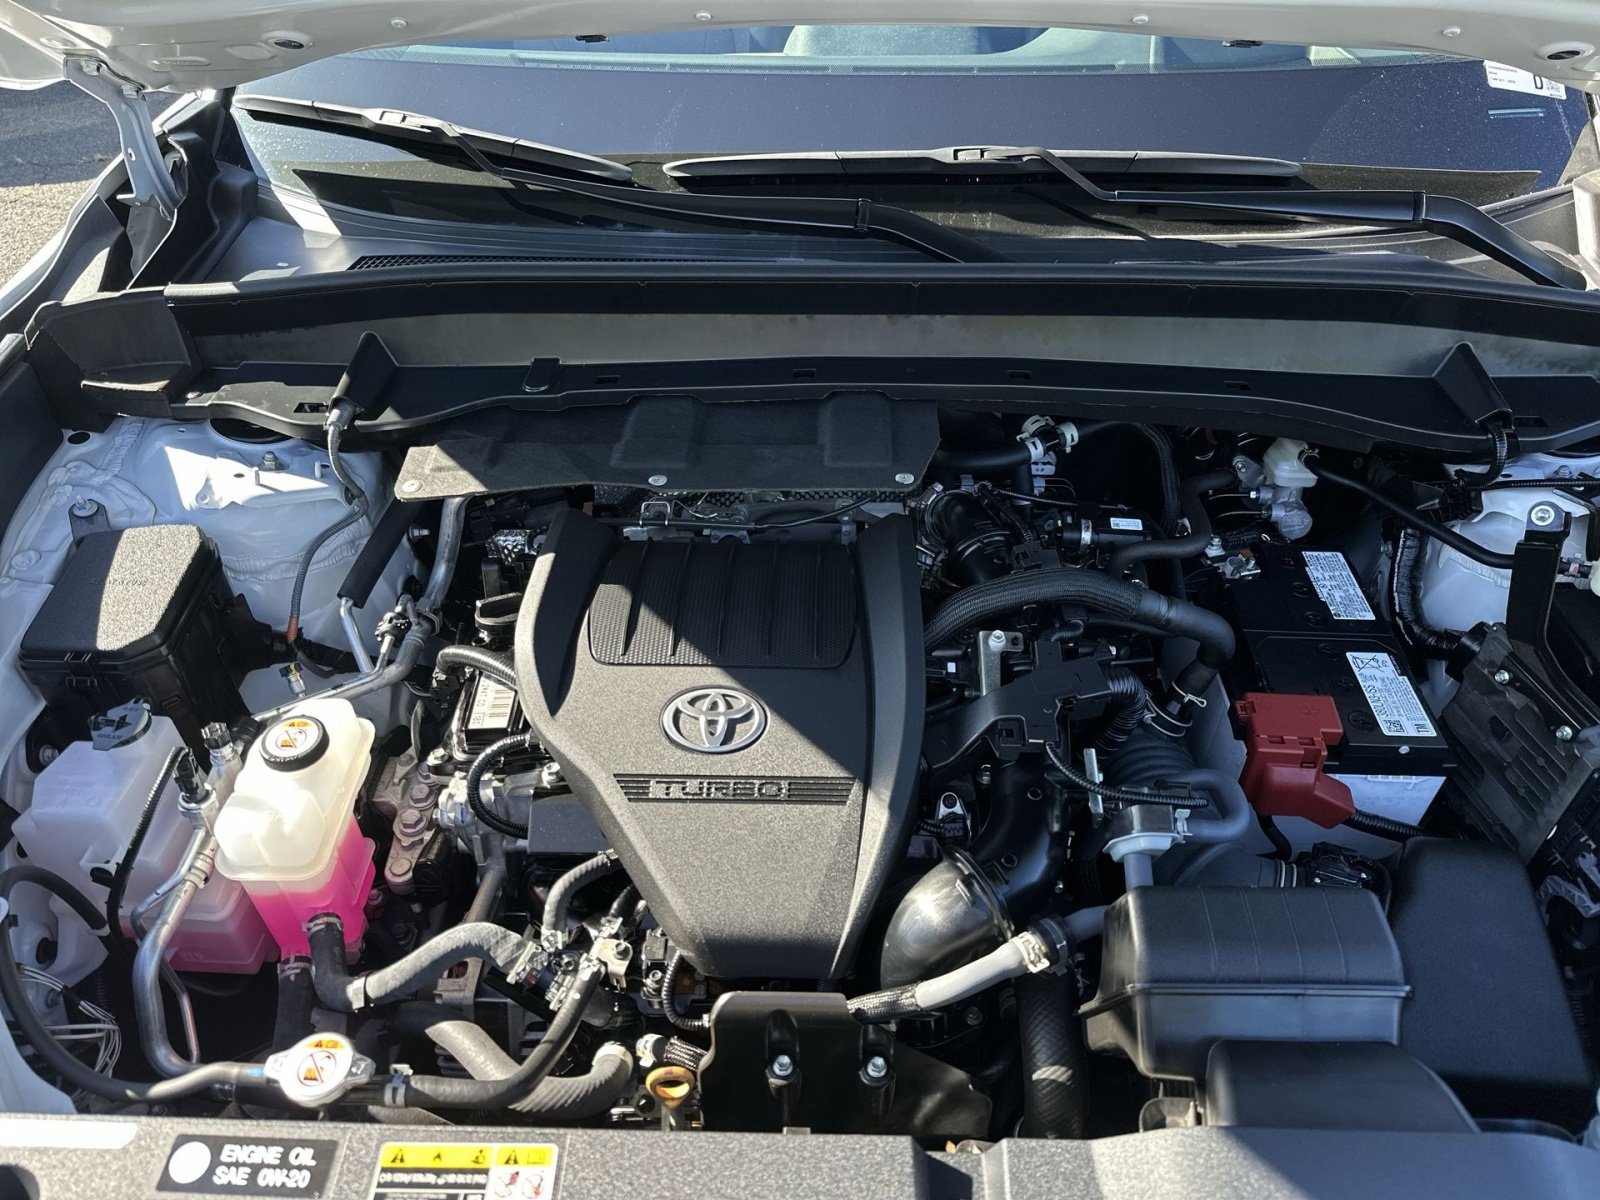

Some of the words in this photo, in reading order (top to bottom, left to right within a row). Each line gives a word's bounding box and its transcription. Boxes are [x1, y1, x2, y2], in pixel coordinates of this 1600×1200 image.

[649, 779, 789, 800] TURBO
[220, 1144, 284, 1164] ENGINE
[288, 1146, 317, 1166] OIL
[212, 1165, 251, 1186] SAE
[256, 1167, 311, 1189] 0W-20
